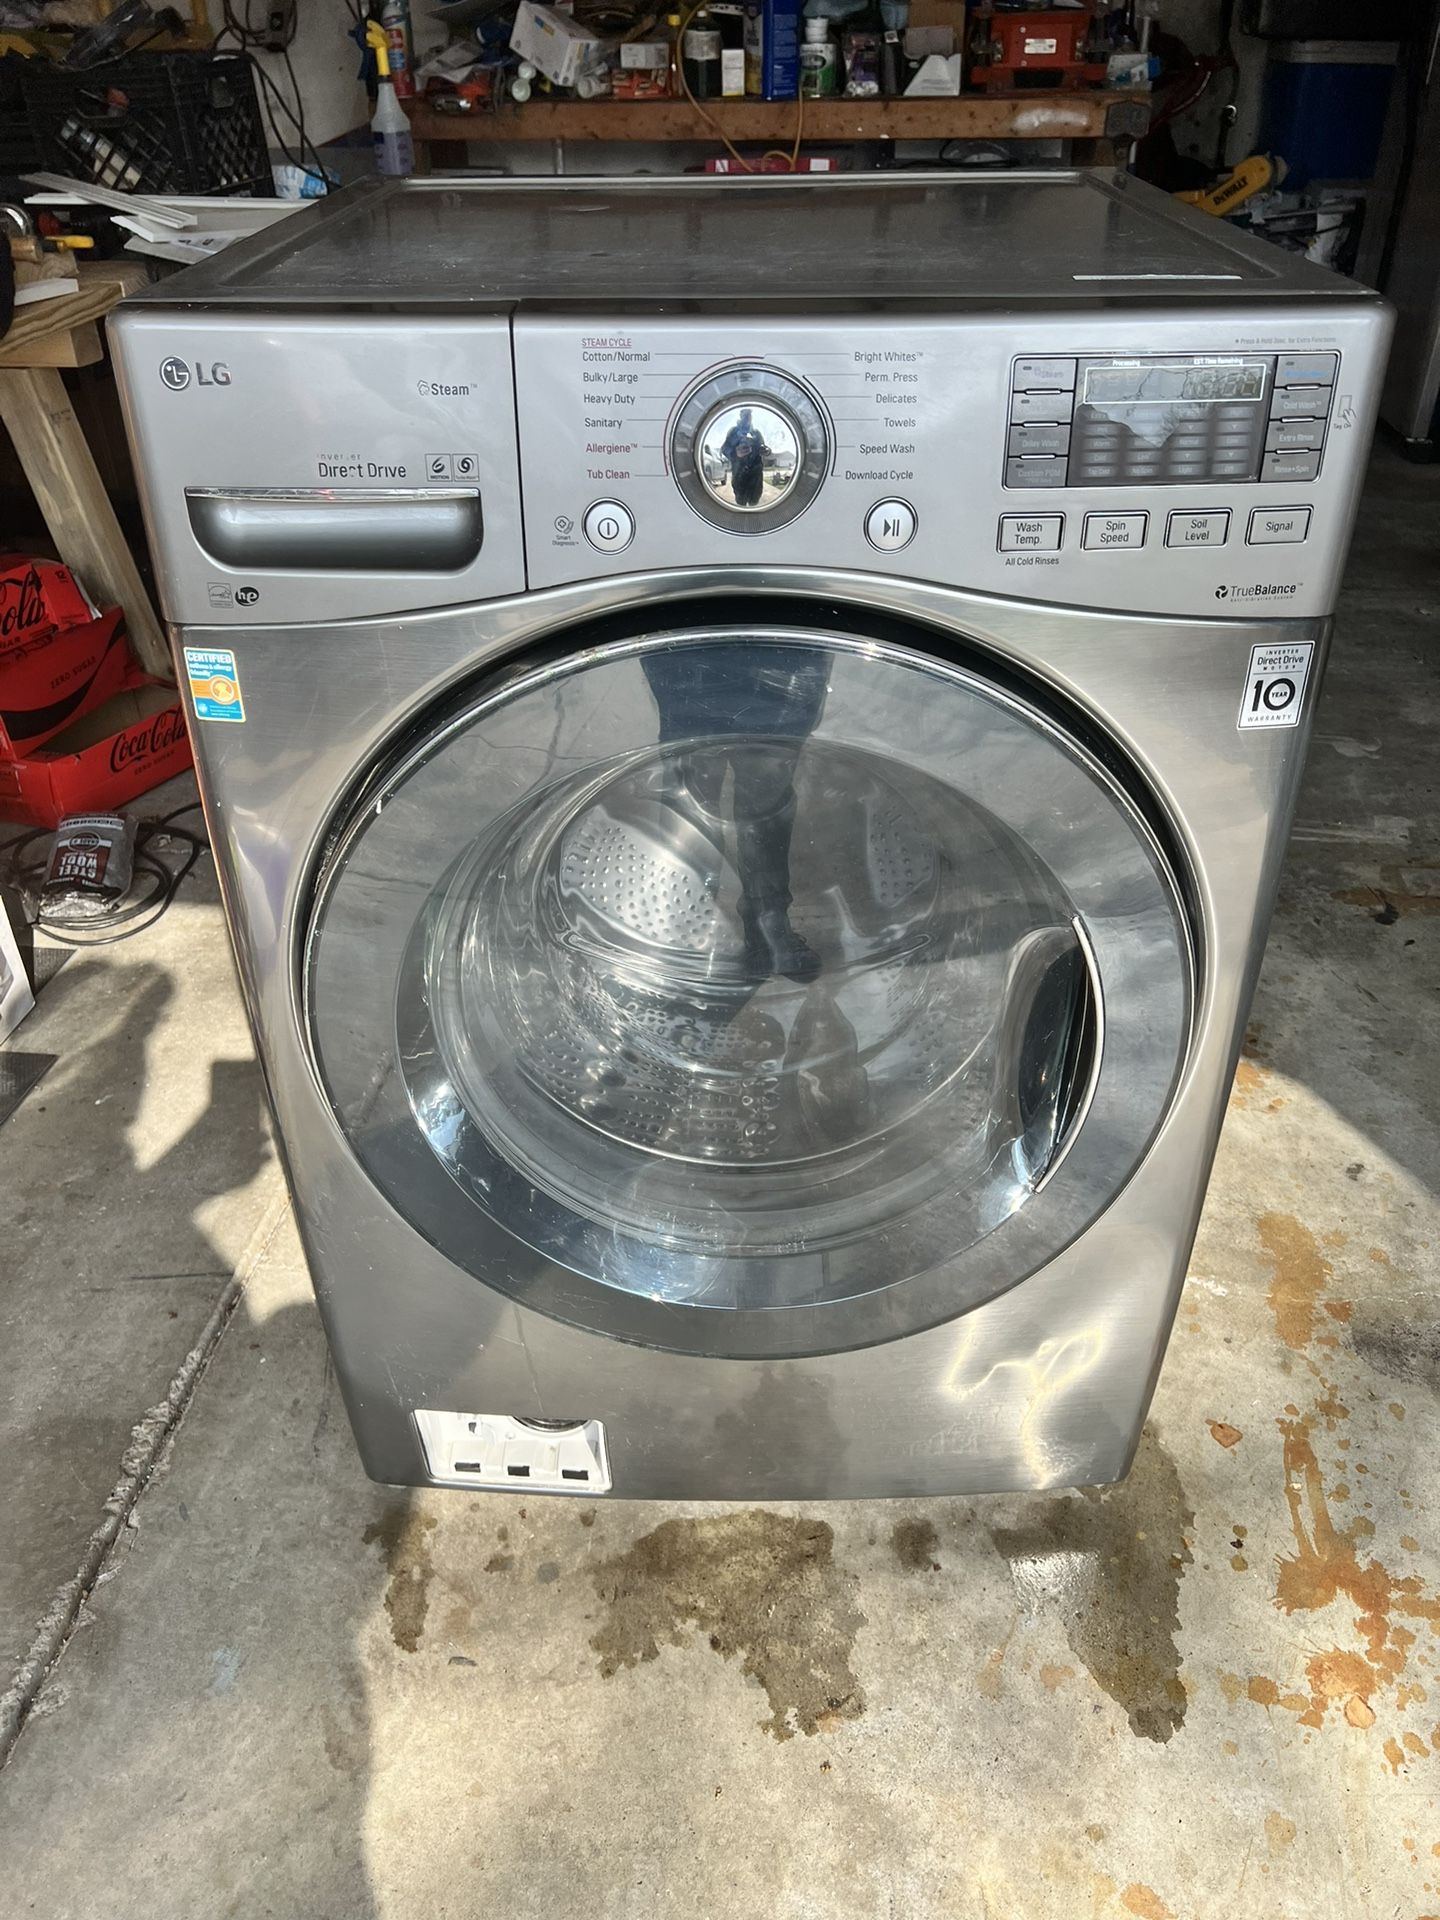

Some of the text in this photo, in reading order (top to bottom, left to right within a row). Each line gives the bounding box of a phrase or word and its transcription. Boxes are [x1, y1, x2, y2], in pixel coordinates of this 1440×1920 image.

[582, 338, 632, 347] STEAM CYCLE
[582, 351, 651, 362] Cotton/Normal
[854, 351, 882, 363] Bright
[195, 362, 232, 386] LG
[583, 372, 639, 384] Bulky/Large
[893, 372, 919, 382] Press
[583, 393, 636, 405] Heavy Duty
[875, 393, 917, 404] Delicates
[584, 417, 623, 429] Sanitary
[884, 417, 917, 428] Towels
[859, 444, 916, 455] Speed Wash
[367, 463, 407, 478] Drive
[587, 469, 630, 479] Tub Clean
[845, 470, 914, 481] Download Cycle
[1016, 522, 1043, 532] Wash
[1105, 520, 1126, 532] Spin
[1190, 519, 1208, 529] Soil
[1265, 521, 1293, 533] Signal
[1015, 534, 1042, 545] Temp.
[1100, 532, 1129, 544] Speed
[1185, 531, 1210, 541] Level
[1005, 557, 1060, 566] All Cold Rinses
[187, 651, 232, 663] CERTIFIED
[1257, 655, 1304, 665] Direct Drive
[50, 672, 71, 690] ZERO
[1252, 678, 1296, 712] 10
[1248, 714, 1292, 722] WARRANTY
[61, 855, 98, 868] WOOL
[58, 865, 97, 879] STEEL
